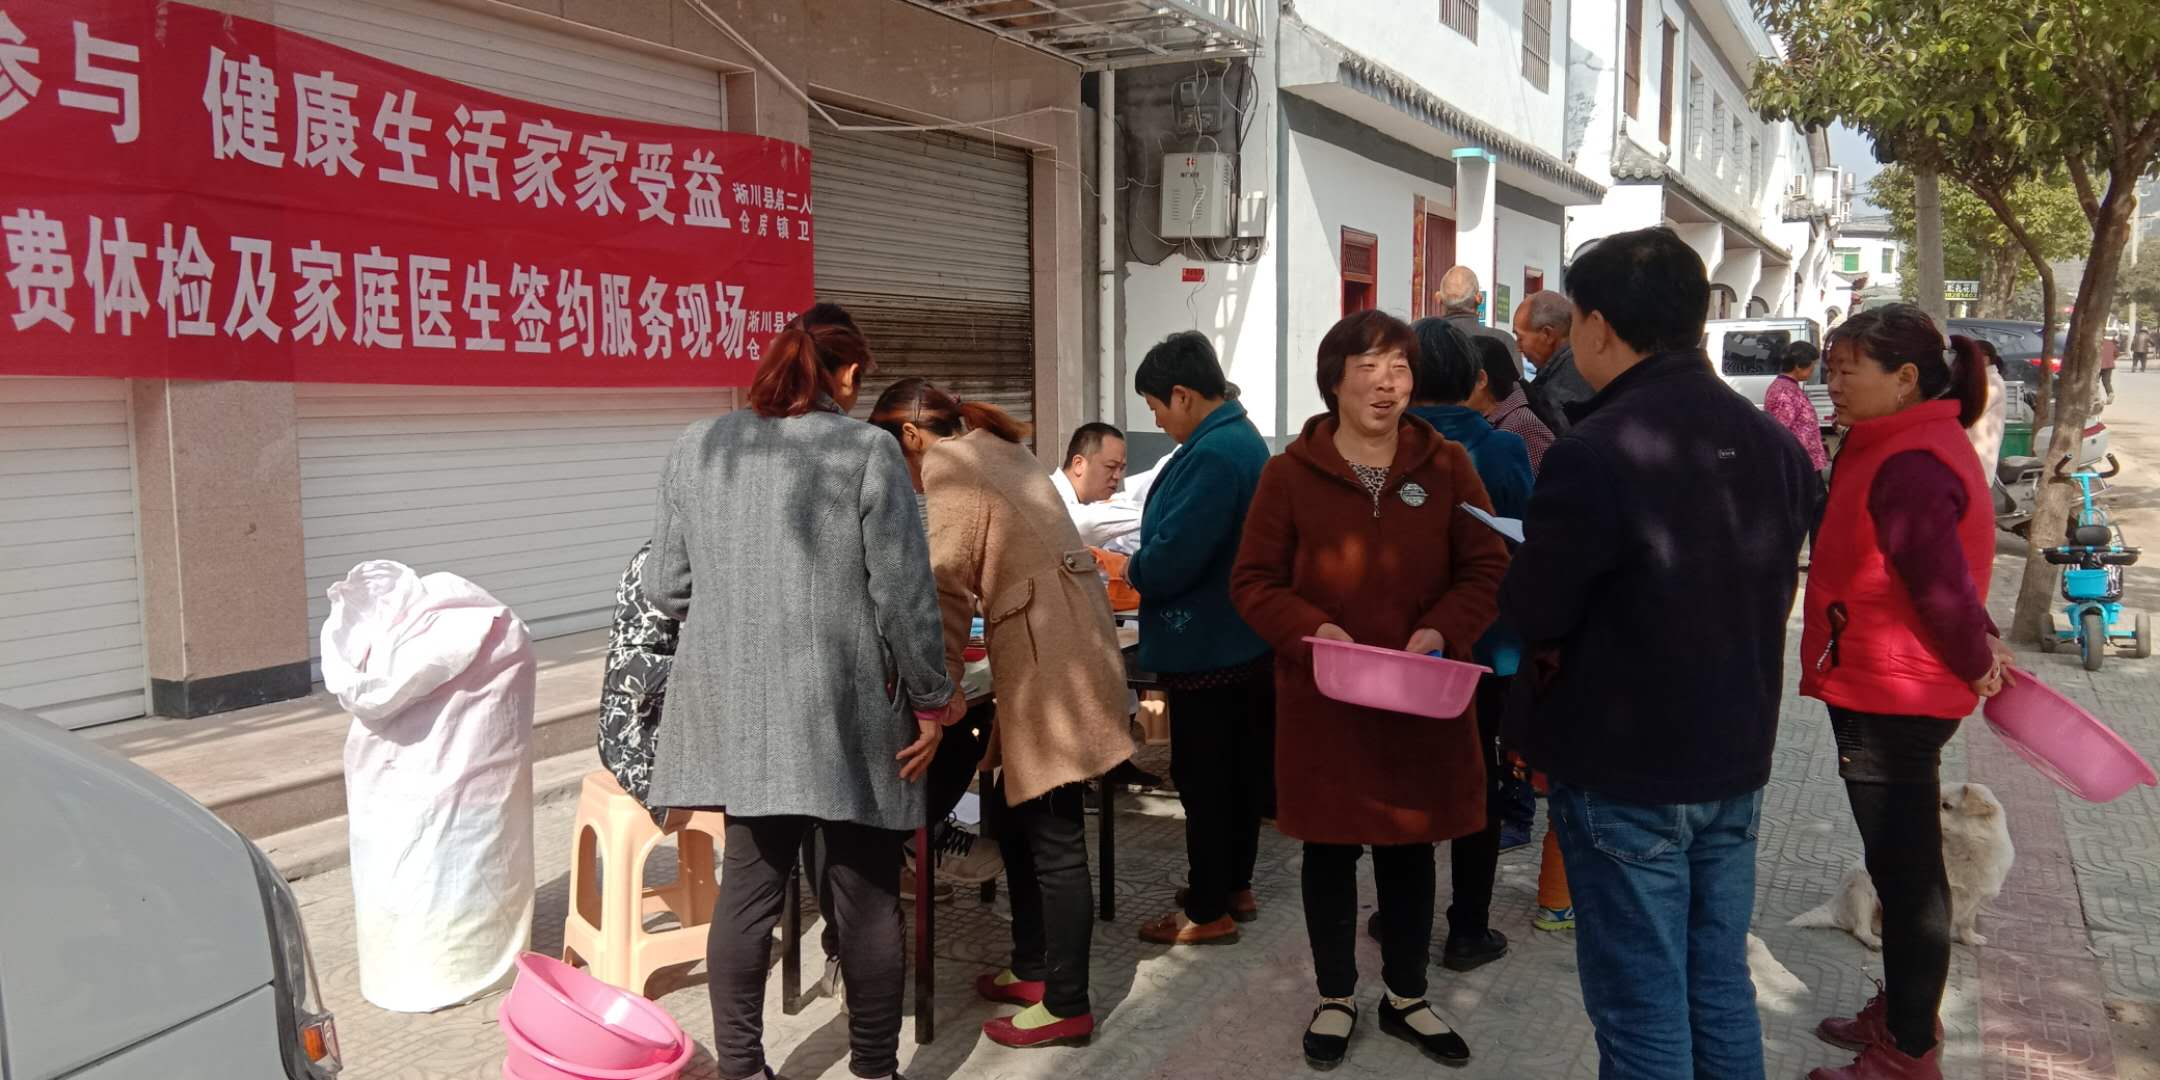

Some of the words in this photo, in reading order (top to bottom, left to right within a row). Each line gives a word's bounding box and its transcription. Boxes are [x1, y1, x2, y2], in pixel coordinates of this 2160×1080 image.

[202, 45, 730, 229] 健康生活家家受益
[732, 182, 812, 215] 淅川县第二人
[1, 208, 746, 360] 费体检及家庭医生签约服务现场
